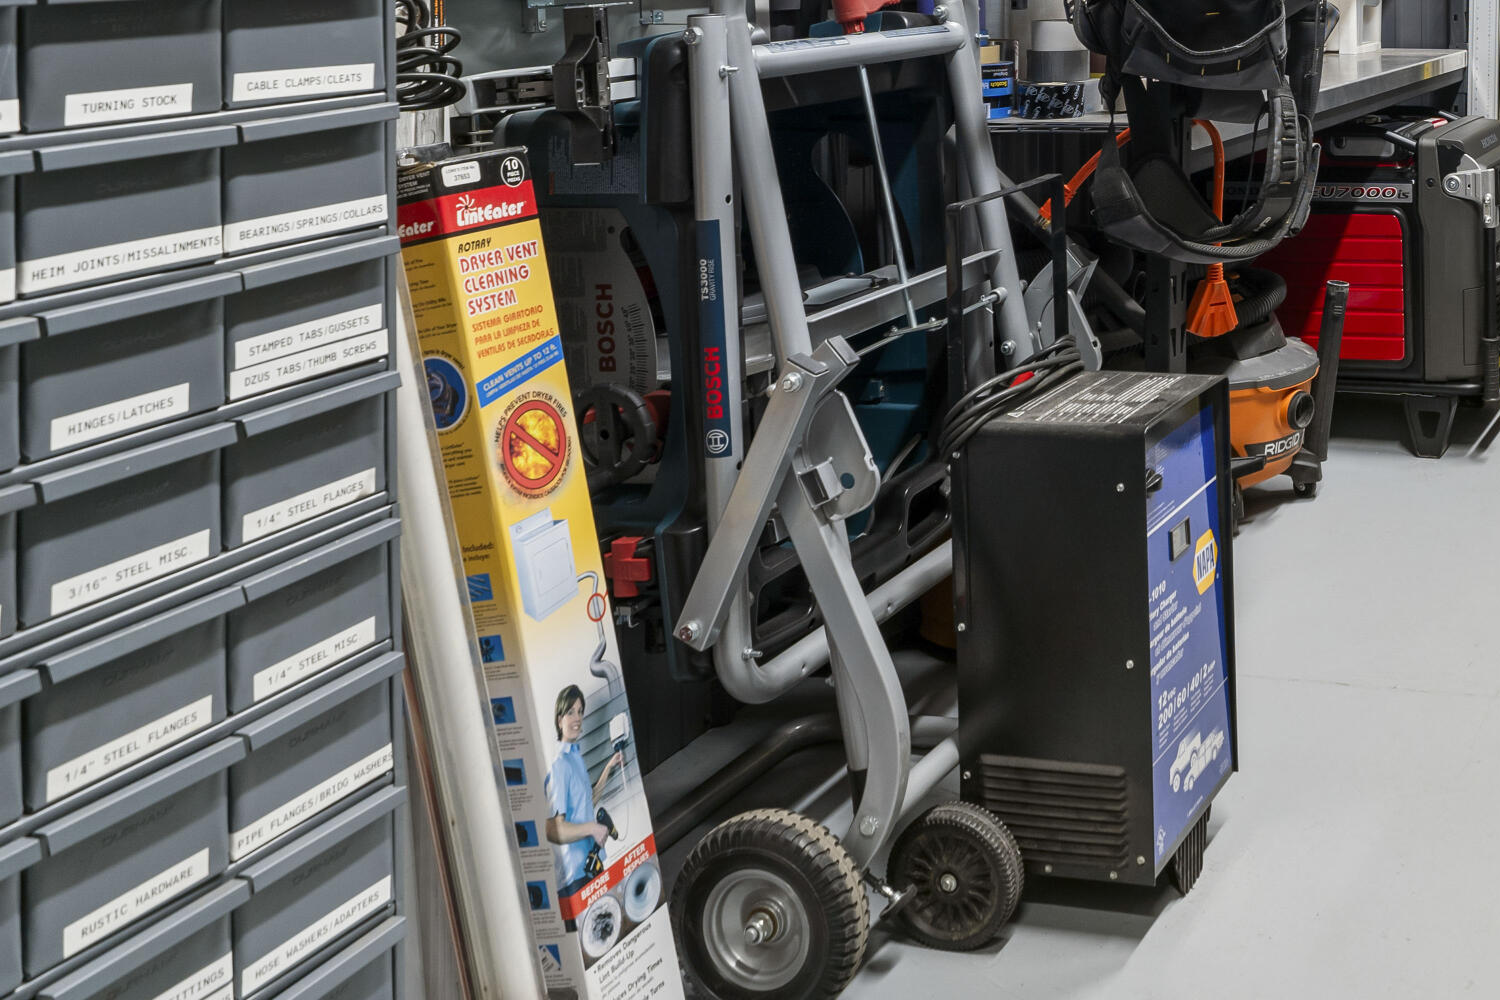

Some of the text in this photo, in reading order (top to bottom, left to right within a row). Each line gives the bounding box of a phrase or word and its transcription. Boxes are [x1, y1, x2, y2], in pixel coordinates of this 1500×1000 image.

[247, 73, 362, 91] CABLE CLAMPS/CLEATS
[82, 94, 177, 114] TURNING STOCK
[505, 160, 518, 171] 10
[240, 204, 383, 241] BEARINGS/SPRINGS/COLLARS
[398, 221, 434, 237] Eater
[456, 201, 525, 227] LintEater
[32, 235, 220, 281] HEIM JOINTS/MISSALINMENTS
[457, 237, 492, 254] ROTARY
[459, 250, 503, 275] DRYER
[507, 240, 539, 261] VENT
[464, 264, 530, 294] CLEANING
[700, 259, 709, 302] TS3000
[467, 288, 518, 316] SYSTEM
[249, 315, 369, 357] STAMPED TABS/GUSSETS
[595, 284, 617, 373] BOSCH
[244, 340, 376, 387] DZUS TABS/THUMB SCREWS
[704, 347, 724, 420] BOSCH
[68, 397, 173, 436] HINGES/LATCHES
[503, 392, 531, 417] PREVENT
[532, 390, 553, 400] DRYER
[552, 398, 568, 418] FIRES
[1264, 432, 1300, 456] RIDGID
[288, 498, 317, 517] STEEL
[323, 481, 364, 504] FLANGES
[115, 557, 151, 582] STEEL
[1196, 541, 1216, 580] NAPA
[299, 649, 328, 671] STEEL
[104, 740, 140, 765] STEEL
[148, 711, 197, 744] FLANGES
[238, 827, 263, 849] PIPE
[624, 843, 646, 865] AFTER
[81, 866, 193, 938] RUSTIC HARDWARE
[580, 873, 610, 900] BEFORE
[255, 891, 380, 979] HOSE WASHERS/ADAPTERS
[168, 966, 225, 1000] ITTINGS
